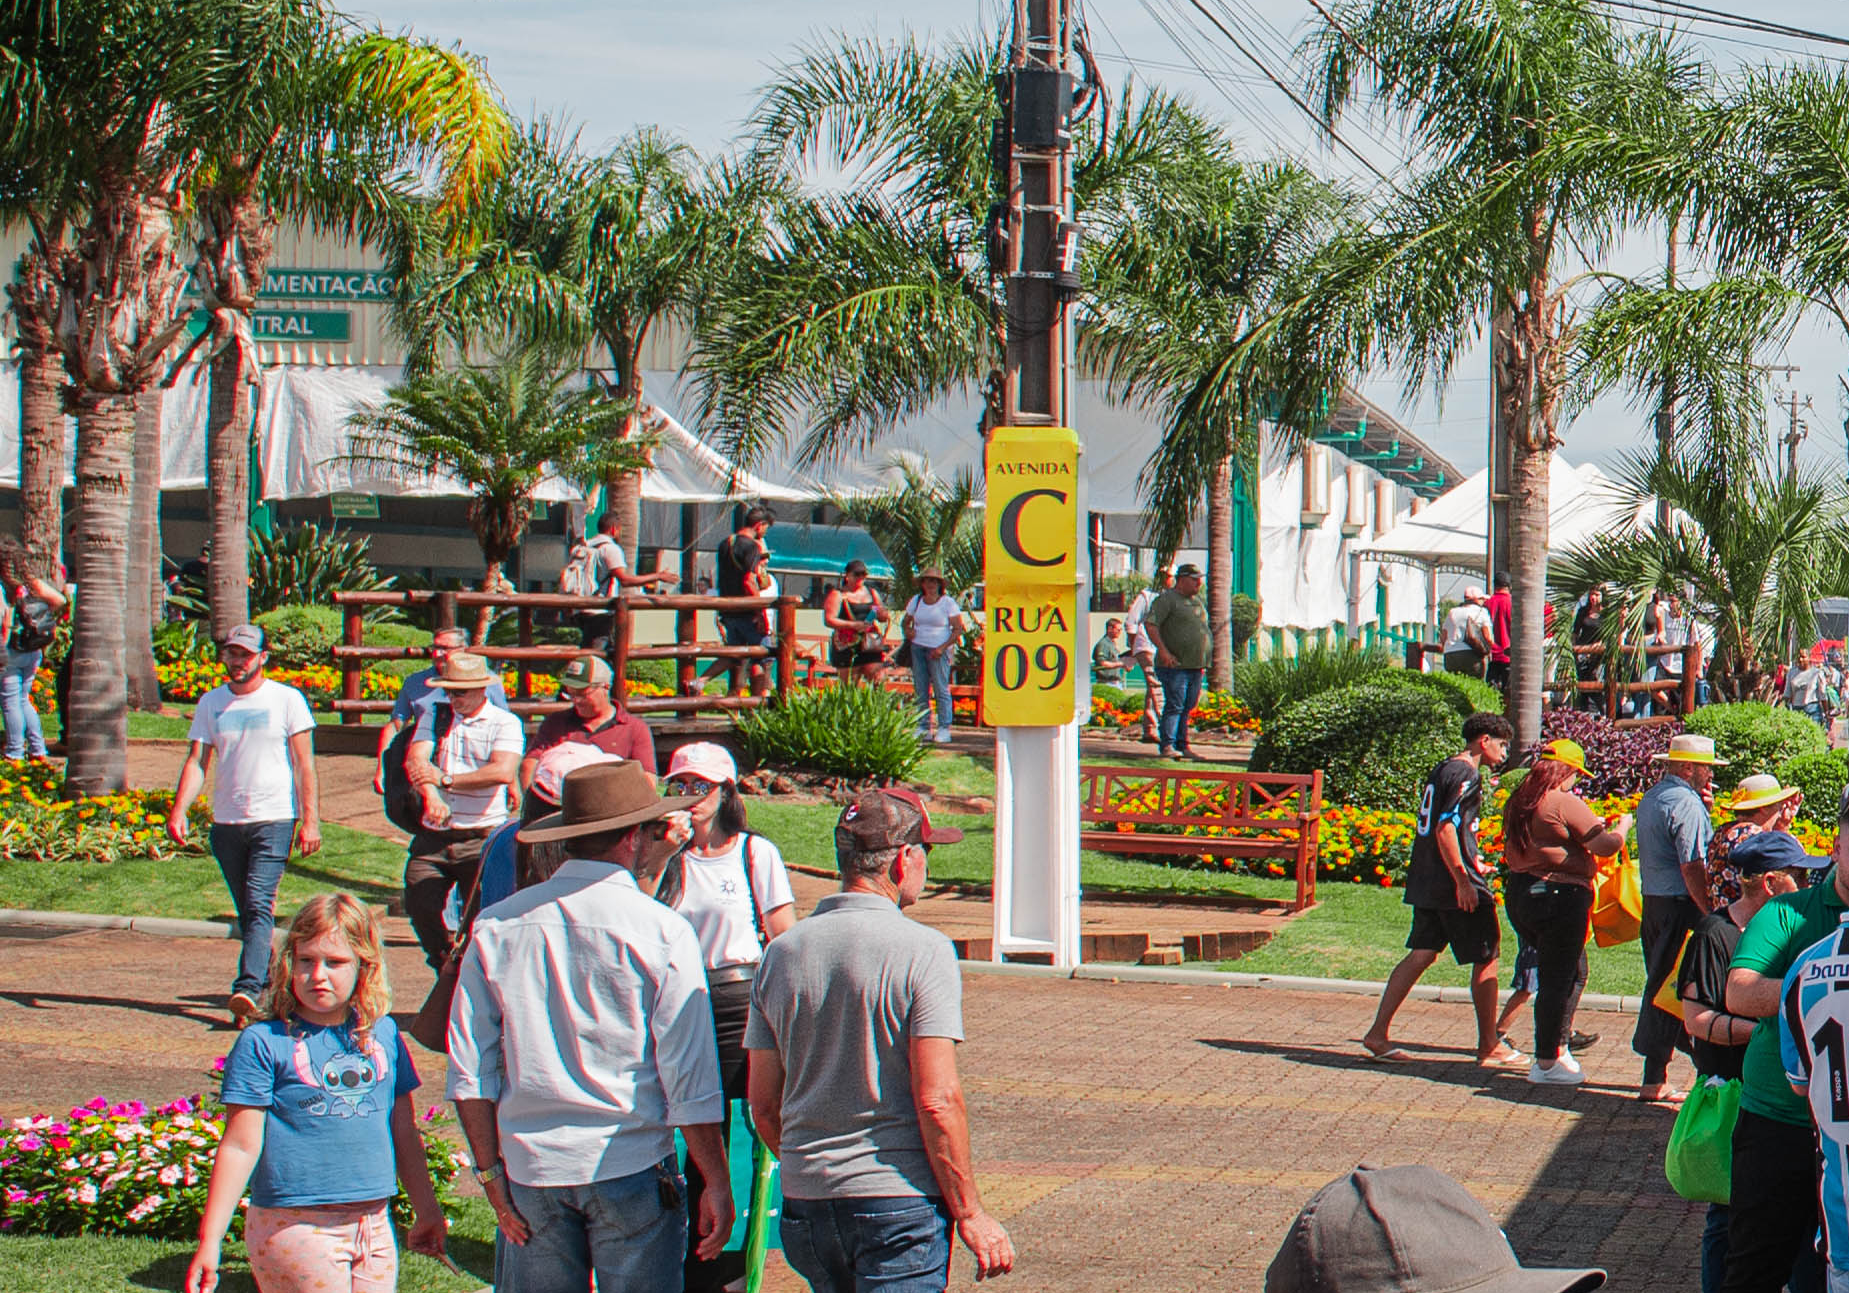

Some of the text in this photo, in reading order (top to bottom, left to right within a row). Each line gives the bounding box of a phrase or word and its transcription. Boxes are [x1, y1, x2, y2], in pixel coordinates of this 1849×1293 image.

[994, 461, 1071, 476] AVENIDA
[999, 488, 1069, 567] C
[992, 606, 1069, 634] RUA
[993, 643, 1069, 692] 09
